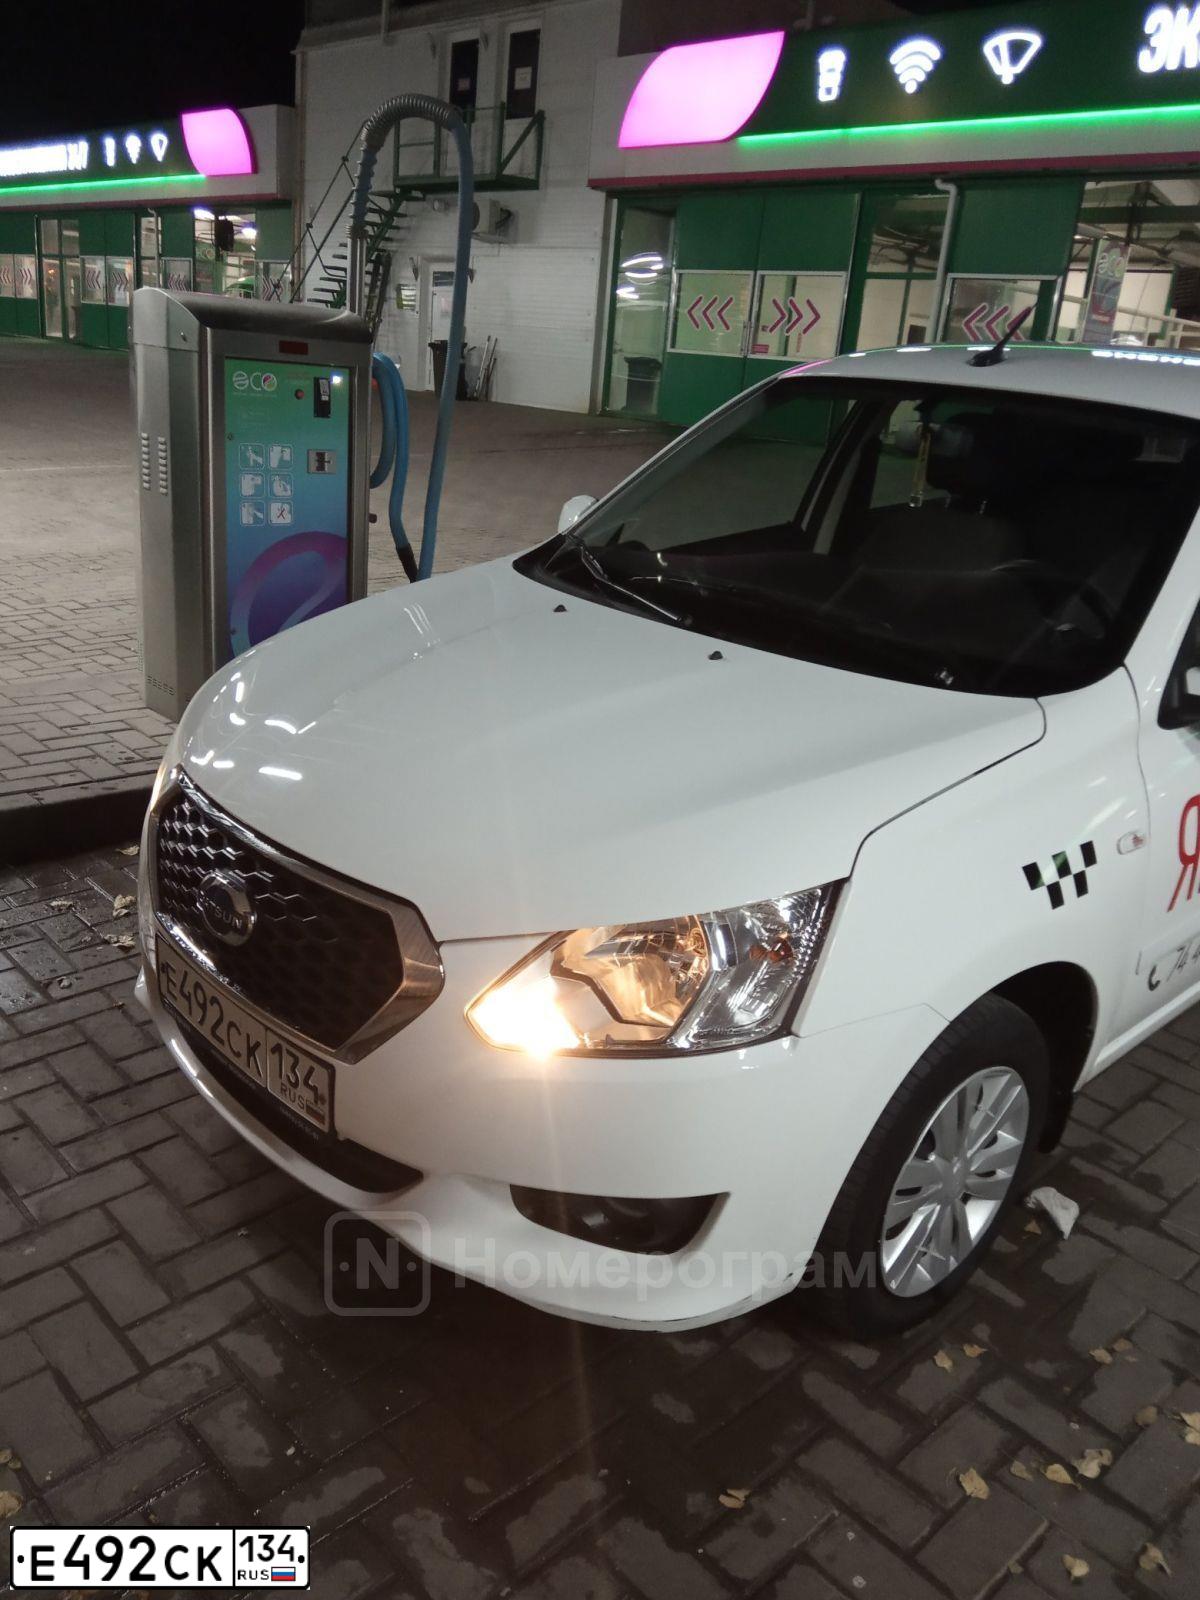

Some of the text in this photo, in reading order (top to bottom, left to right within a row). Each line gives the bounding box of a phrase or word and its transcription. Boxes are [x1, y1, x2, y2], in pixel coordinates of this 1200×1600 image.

[1138, 6, 1200, 73] ЭК
[1167, 793, 1200, 912] Я
[270, 1042, 324, 1105] 134
[280, 1081, 306, 1111] RUS
